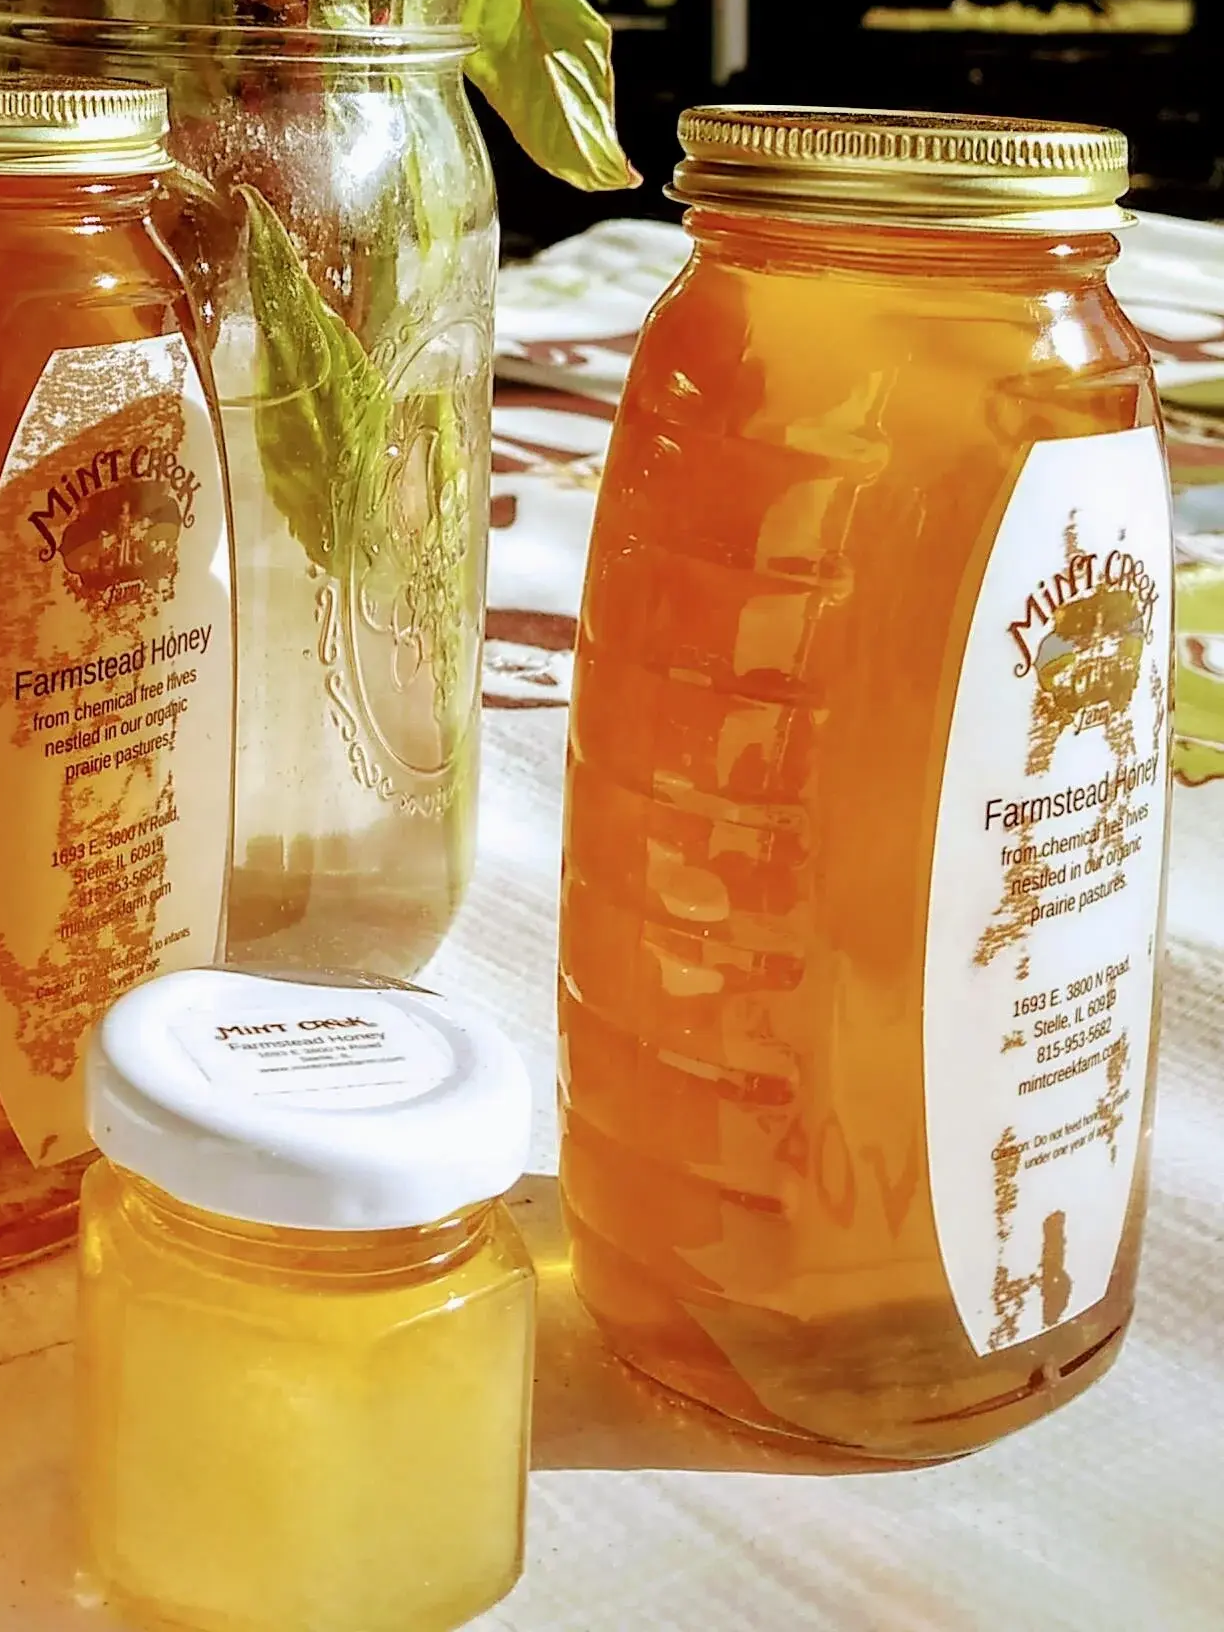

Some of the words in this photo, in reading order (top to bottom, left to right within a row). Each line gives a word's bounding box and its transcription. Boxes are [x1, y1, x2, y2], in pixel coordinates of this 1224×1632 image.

[14, 641, 147, 701] Farmstead
[151, 623, 212, 665] Honey
[33, 710, 69, 732] from
[74, 687, 137, 722] chemical
[140, 681, 164, 703] free
[166, 668, 197, 692] hives
[44, 726, 101, 757] nestled
[104, 721, 117, 742] in
[120, 713, 143, 736] our
[145, 696, 188, 727] organic
[65, 753, 112, 784] prairie
[984, 770, 1109, 831] Farmstead
[1112, 752, 1159, 800] Honey
[51, 842, 85, 868] 1693
[106, 826, 136, 850] 3800
[137, 822, 147, 838] N
[116, 853, 127, 871] IL
[130, 836, 165, 864] 60919
[1000, 844, 1037, 866] from
[1041, 818, 1100, 859] chemical
[1125, 802, 1149, 829] hives
[1011, 864, 1066, 897] nestled
[1069, 860, 1081, 881] in
[1084, 853, 1103, 875] our
[1105, 832, 1142, 866] organic
[1029, 895, 1076, 926] prairie
[1013, 992, 1046, 1018] 1693
[1066, 974, 1093, 1002] 3800
[1095, 969, 1104, 988] N
[1074, 1007, 1085, 1024] IL
[1087, 987, 1117, 1017] 60919
[228, 1036, 325, 1052] Farmstead
[327, 1030, 386, 1043] Honey
[1036, 1016, 1112, 1064] 815-953-5682
[1033, 1134, 1048, 1149] Do
